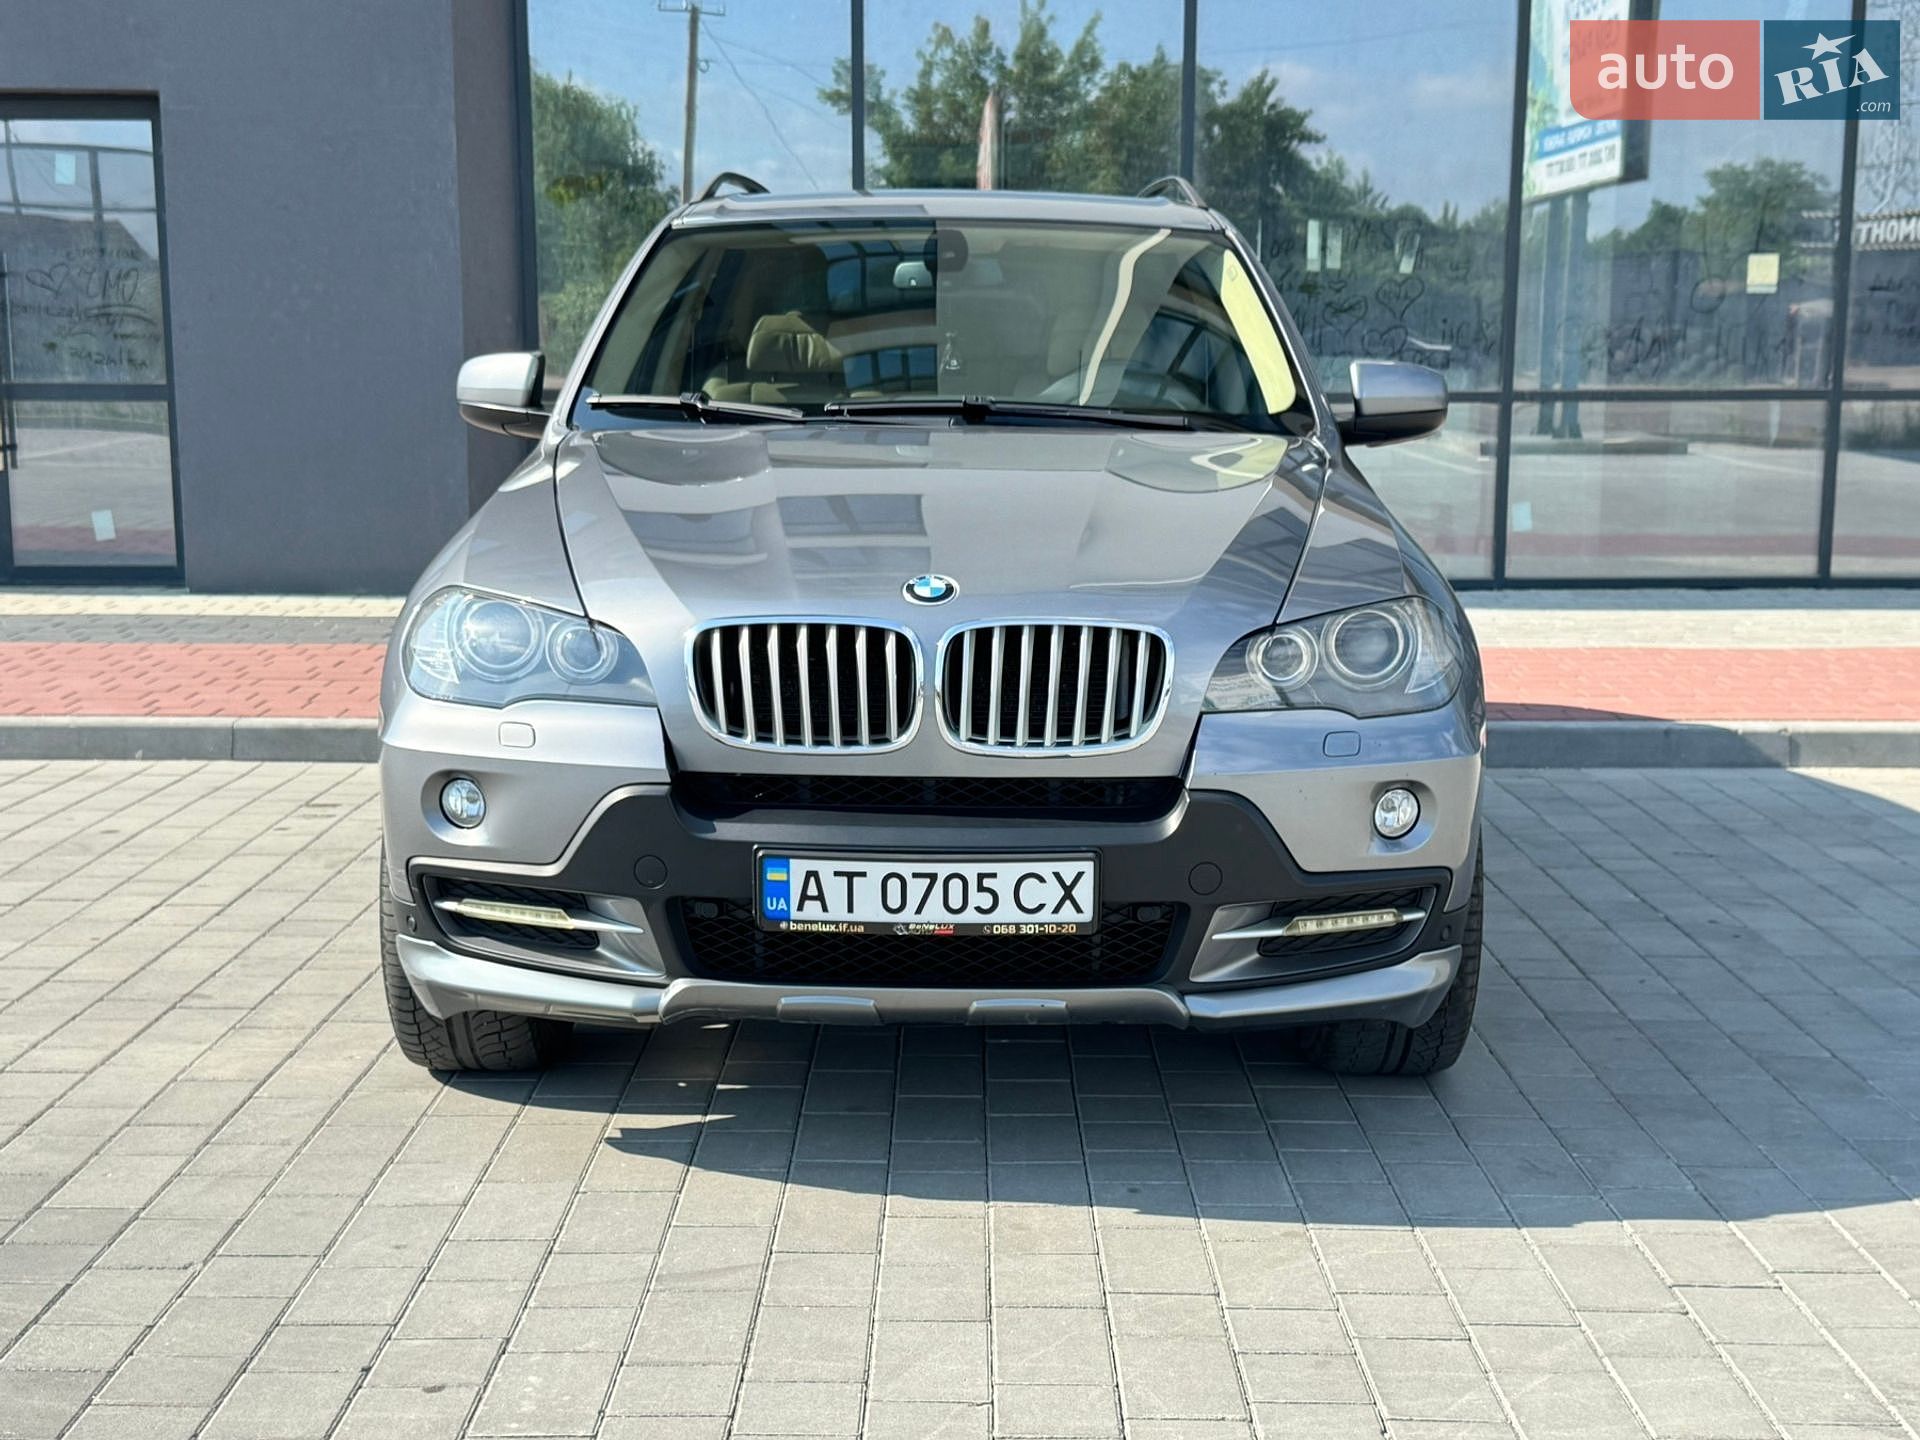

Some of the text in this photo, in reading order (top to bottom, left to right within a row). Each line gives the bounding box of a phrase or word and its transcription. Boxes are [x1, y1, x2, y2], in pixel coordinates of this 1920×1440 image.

[796, 870, 1085, 916] AT 0705 CX
[767, 897, 787, 911] UA
[790, 922, 865, 932] benelux.if.ua
[993, 924, 1077, 934] 068 301-10-20
